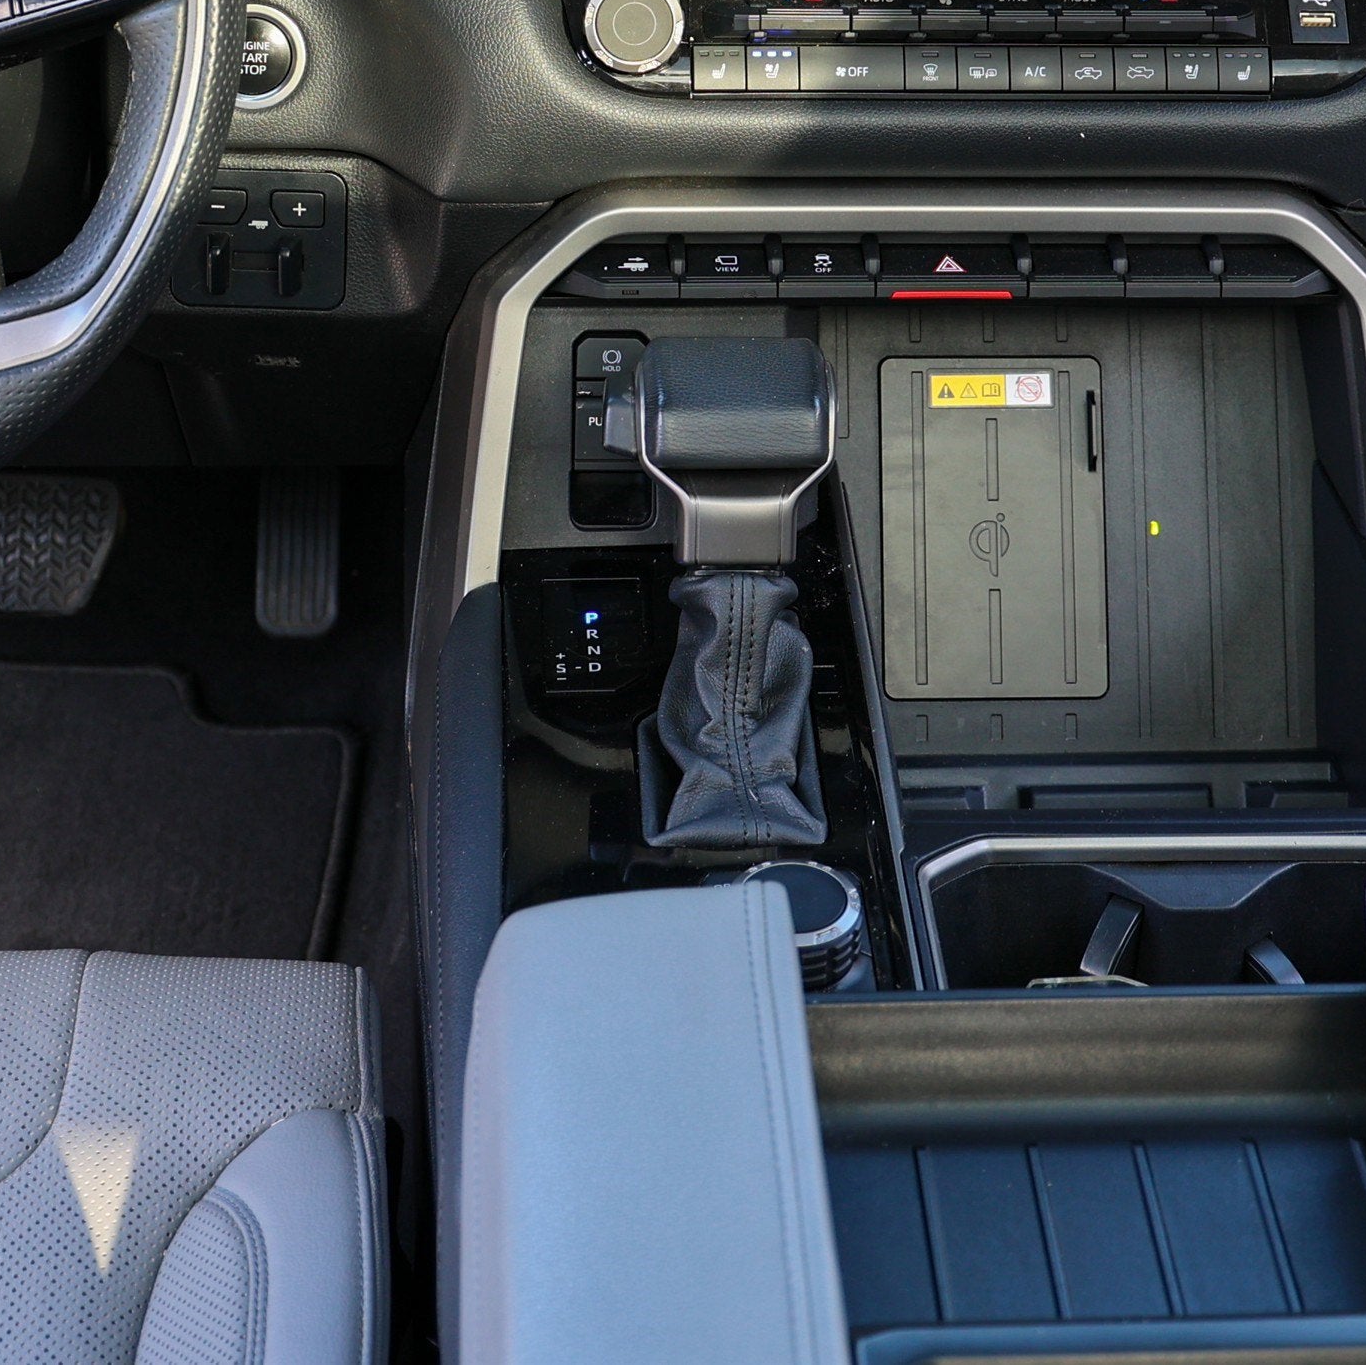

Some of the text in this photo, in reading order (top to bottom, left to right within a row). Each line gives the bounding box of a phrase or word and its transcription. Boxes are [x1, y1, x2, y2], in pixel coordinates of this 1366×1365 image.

[243, 41, 271, 50] GINE
[242, 53, 269, 63] TART
[848, 66, 869, 77] OFF
[1025, 66, 1046, 78] A/C
[588, 416, 603, 426] PU
[585, 612, 598, 624] P
[586, 629, 599, 639] R
[587, 645, 601, 655] N
[556, 663, 566, 673] S
[588, 662, 602, 672] D
